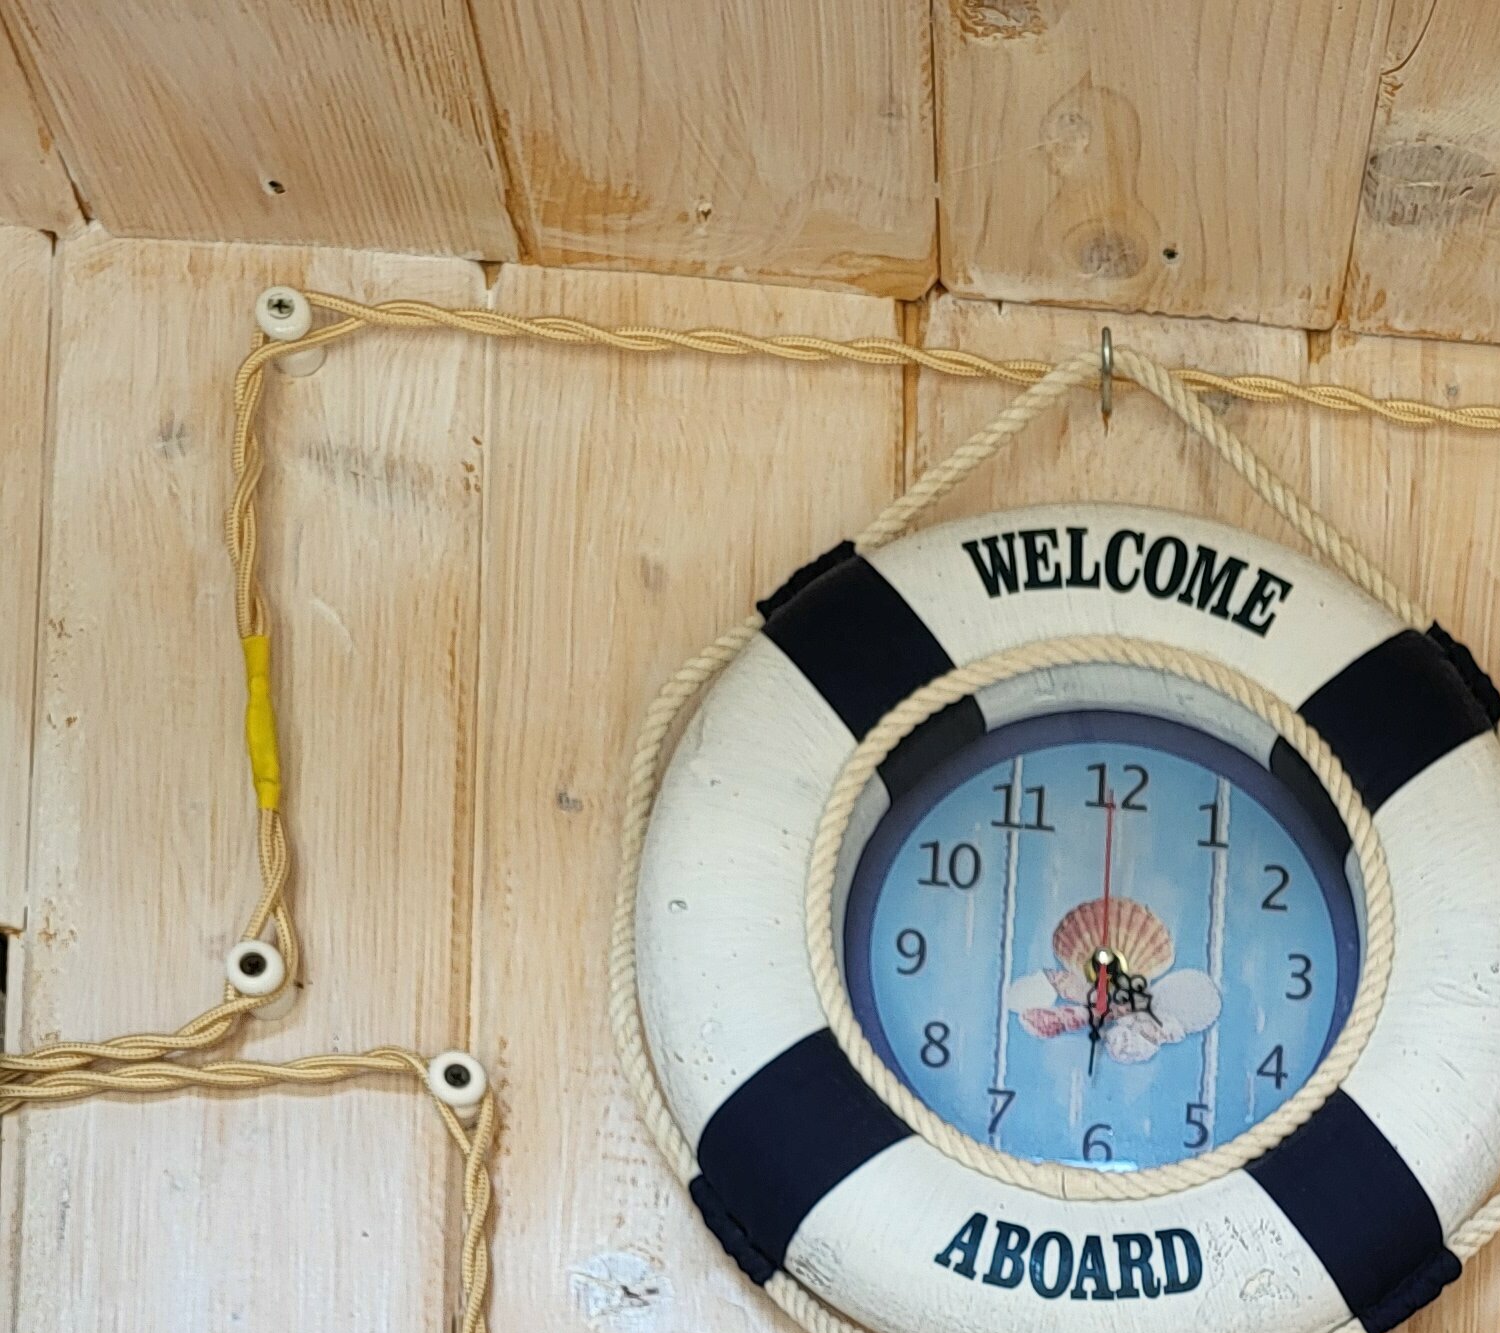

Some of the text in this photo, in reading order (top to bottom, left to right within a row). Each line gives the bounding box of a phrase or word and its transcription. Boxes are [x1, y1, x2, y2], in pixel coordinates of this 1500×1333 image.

[961, 526, 1294, 640] WELCOME
[990, 783, 1055, 834] 11
[1086, 764, 1151, 811] 12
[1197, 802, 1231, 851] 1
[917, 841, 983, 891] 10
[1261, 865, 1292, 912] 2
[894, 929, 928, 976] 9
[1284, 955, 1316, 1002] 3
[920, 1021, 952, 1069] 8
[1256, 1045, 1289, 1091] 4
[988, 1088, 1017, 1138] 7
[1184, 1103, 1212, 1150] 5
[1082, 1123, 1114, 1165] 6
[934, 1212, 1204, 1302] ABOARD
